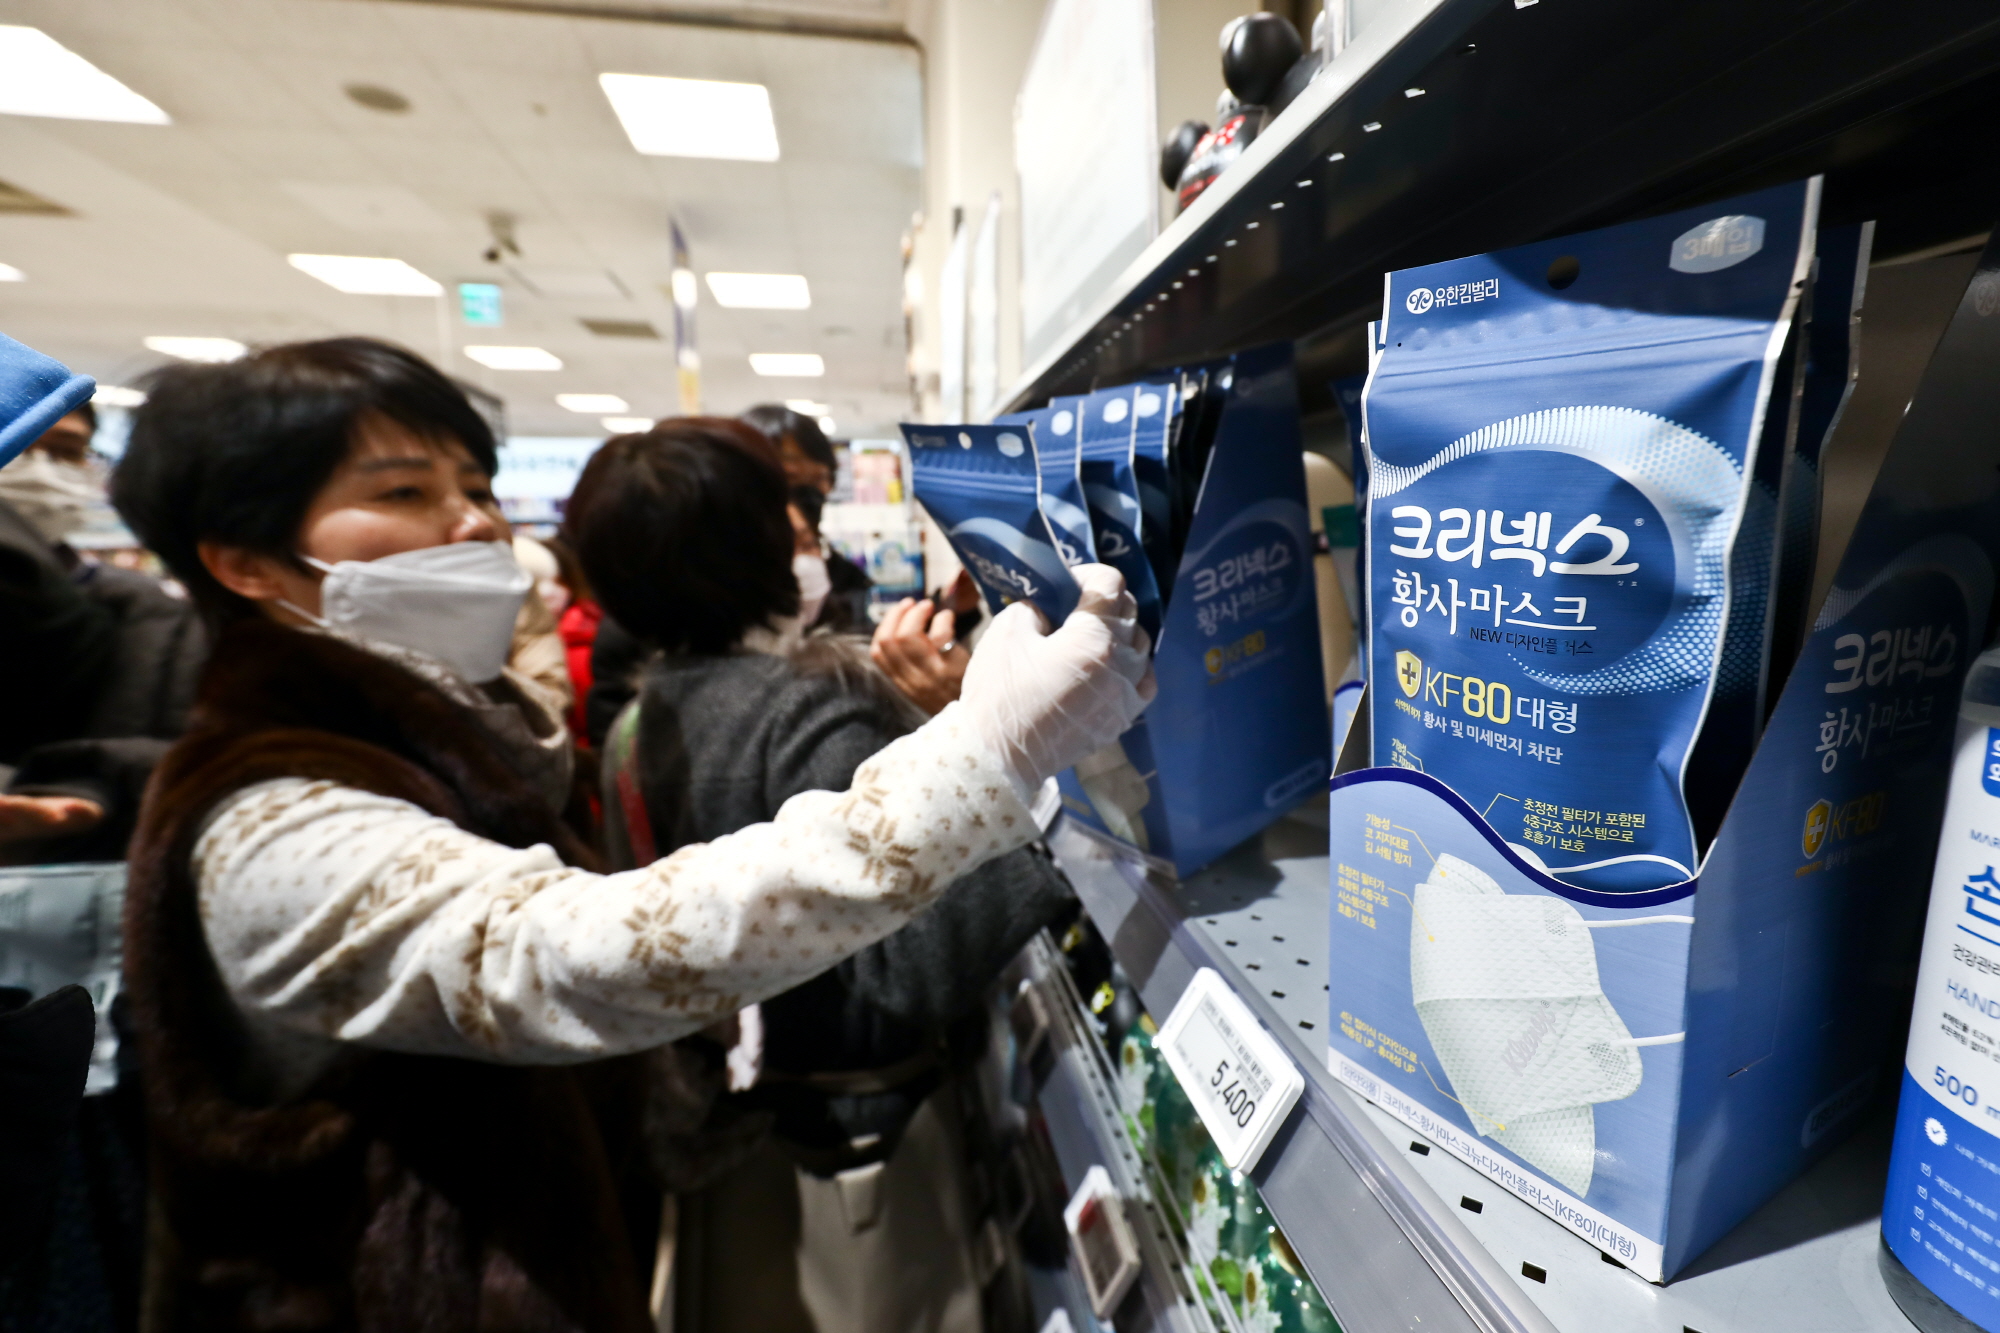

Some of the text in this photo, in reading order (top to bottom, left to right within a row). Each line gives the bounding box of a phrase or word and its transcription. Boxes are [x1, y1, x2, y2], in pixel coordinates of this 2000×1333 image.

[1434, 278, 1499, 308] 유한킴벌리
[1390, 505, 1640, 577] 크리넥스
[1193, 543, 1291, 601] 크리넥스
[1391, 569, 1597, 635] 황사마스크
[1469, 627, 1502, 644] NEW
[1825, 623, 1957, 693] 크리넥스
[1425, 666, 1578, 734] KF80 대형
[1423, 711, 1563, 765] 황사 및 미세먼지 차단
[1815, 695, 1933, 774] 황사마스크
[1365, 813, 1390, 830] 기능성
[1523, 798, 1646, 828] 초정전 필터가 포함된
[1523, 813, 1635, 843] 4중구조 시스템으로
[1365, 827, 1410, 851] 코 지지대로
[1365, 840, 1374, 854] 김
[1393, 850, 1412, 867] 방지
[1522, 827, 1586, 853] 호흡기 보호
[1946, 978, 2000, 1019] HAND
[1211, 1060, 1256, 1128] 5,400
[1933, 1065, 1978, 1107] 500
